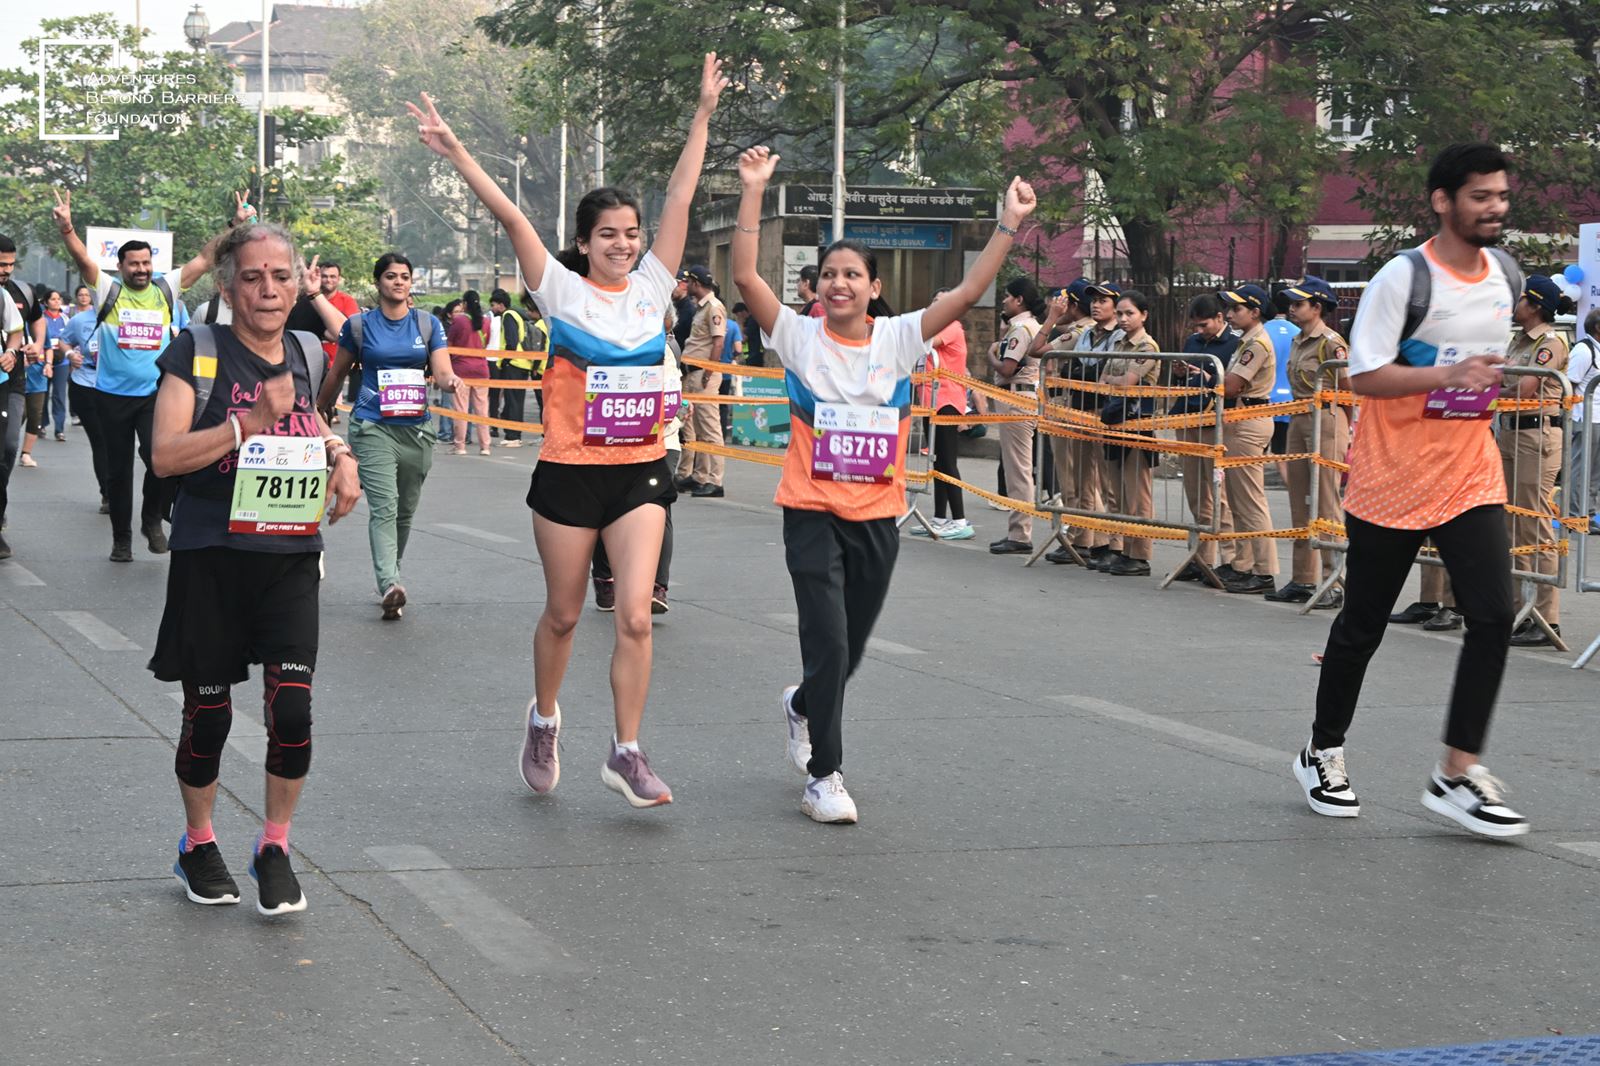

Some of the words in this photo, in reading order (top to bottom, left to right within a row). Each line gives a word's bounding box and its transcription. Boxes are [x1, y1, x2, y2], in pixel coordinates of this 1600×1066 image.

[125, 325, 155, 337] 88557
[387, 389, 419, 400] 86790
[601, 397, 655, 418] 65649
[829, 434, 889, 459] 65713
[243, 457, 266, 465] TATA
[255, 475, 320, 499] 78112
